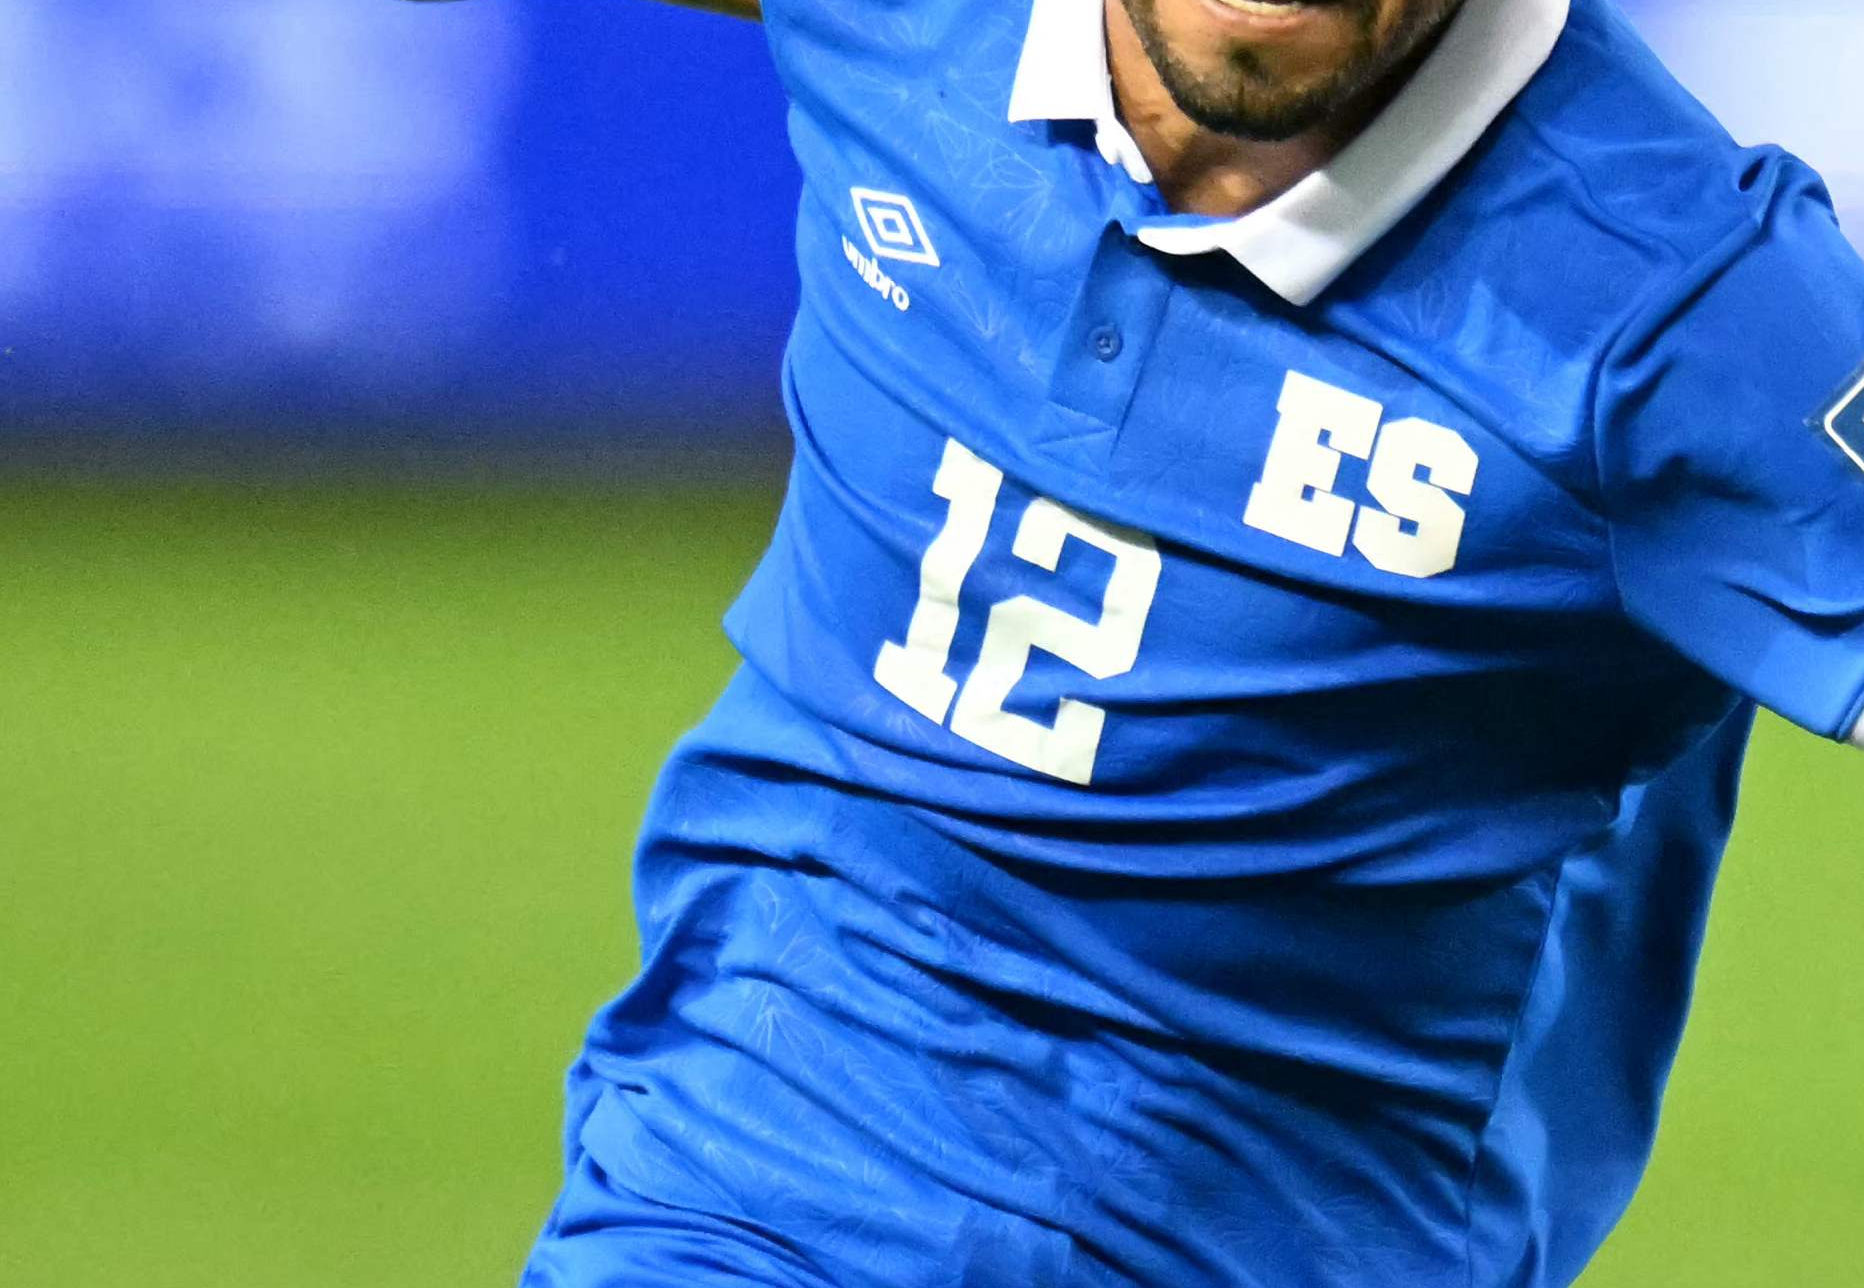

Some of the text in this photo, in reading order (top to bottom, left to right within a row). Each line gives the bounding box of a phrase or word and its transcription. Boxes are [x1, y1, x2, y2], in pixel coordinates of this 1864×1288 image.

[841, 232, 911, 312] umbro
[1243, 369, 1479, 579] ES
[874, 437, 1162, 786] 12
